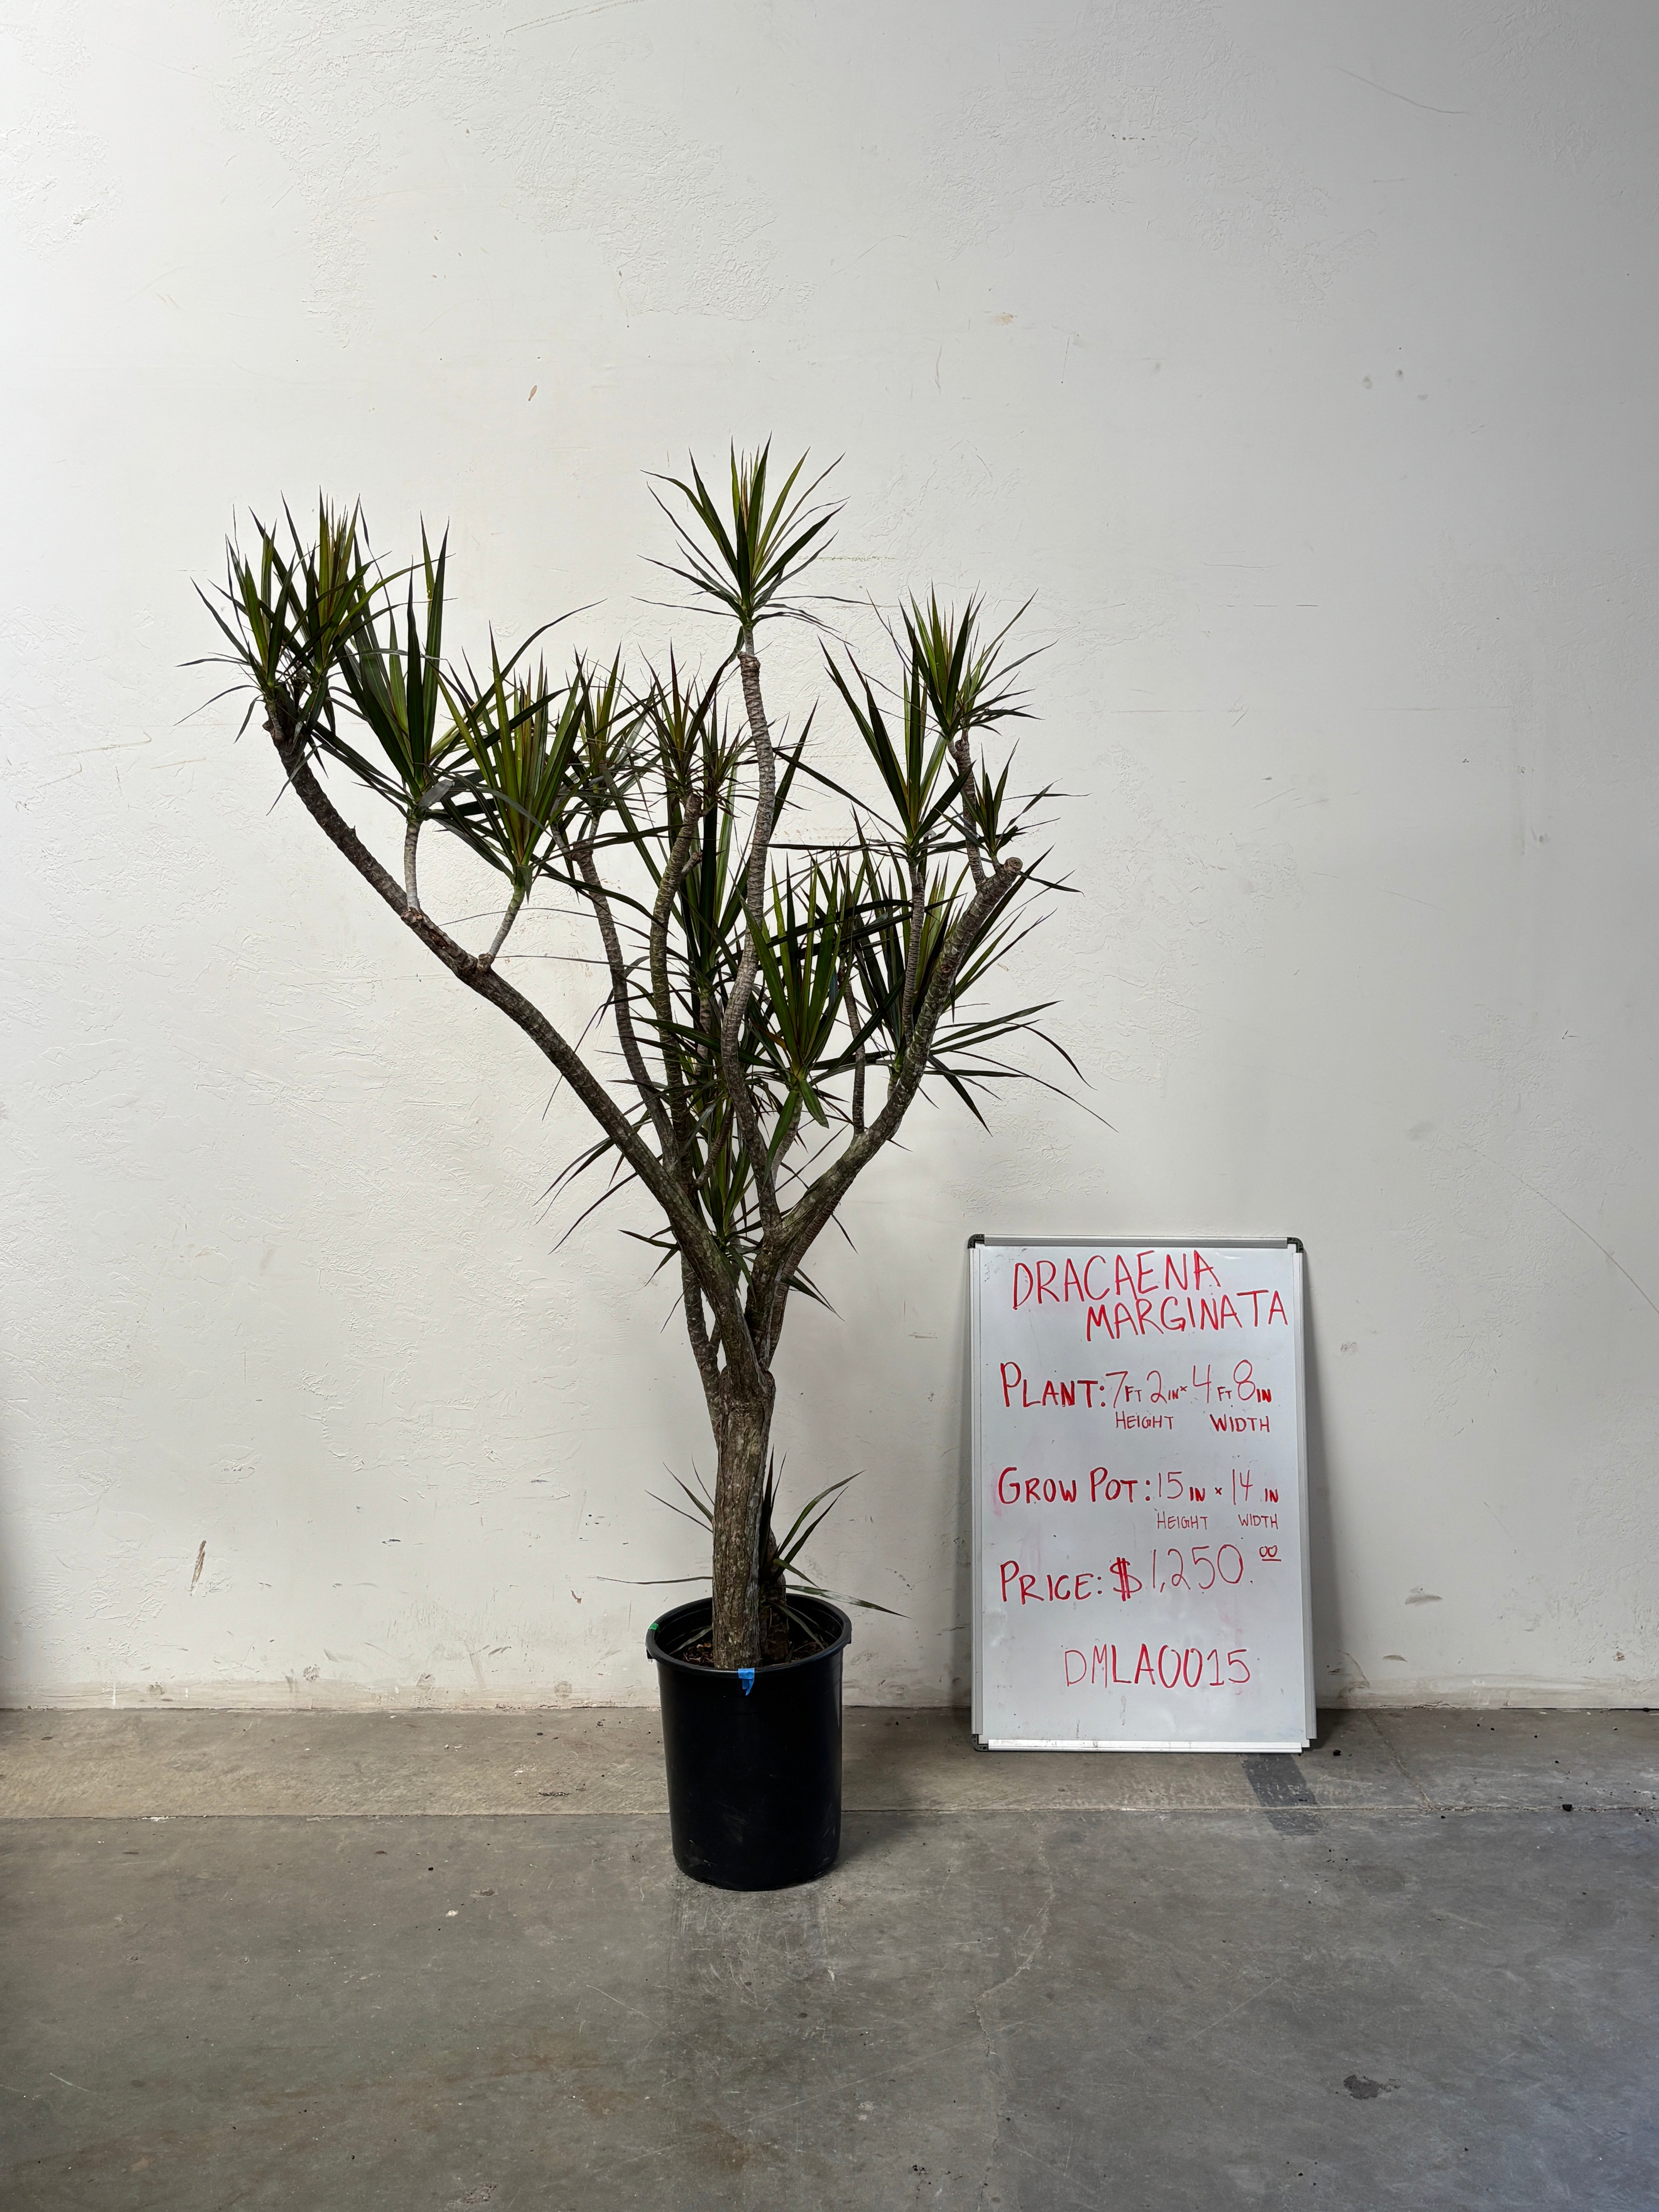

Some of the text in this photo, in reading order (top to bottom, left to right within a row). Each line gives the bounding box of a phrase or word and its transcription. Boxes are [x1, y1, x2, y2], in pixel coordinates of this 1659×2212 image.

[1012, 1250, 1223, 1310] DRACAENA
[1085, 1290, 1288, 1342] MARGINATA
[1000, 1362, 1105, 1408] PLANT:
[1115, 1411, 1269, 1433] HEIGHT WIDTH
[998, 1467, 1077, 1505] GROW
[1089, 1467, 1150, 1503] POT:
[1157, 1511, 1278, 1529] HEIGHT WIDTH
[1000, 1560, 1101, 1605] PRICE:
